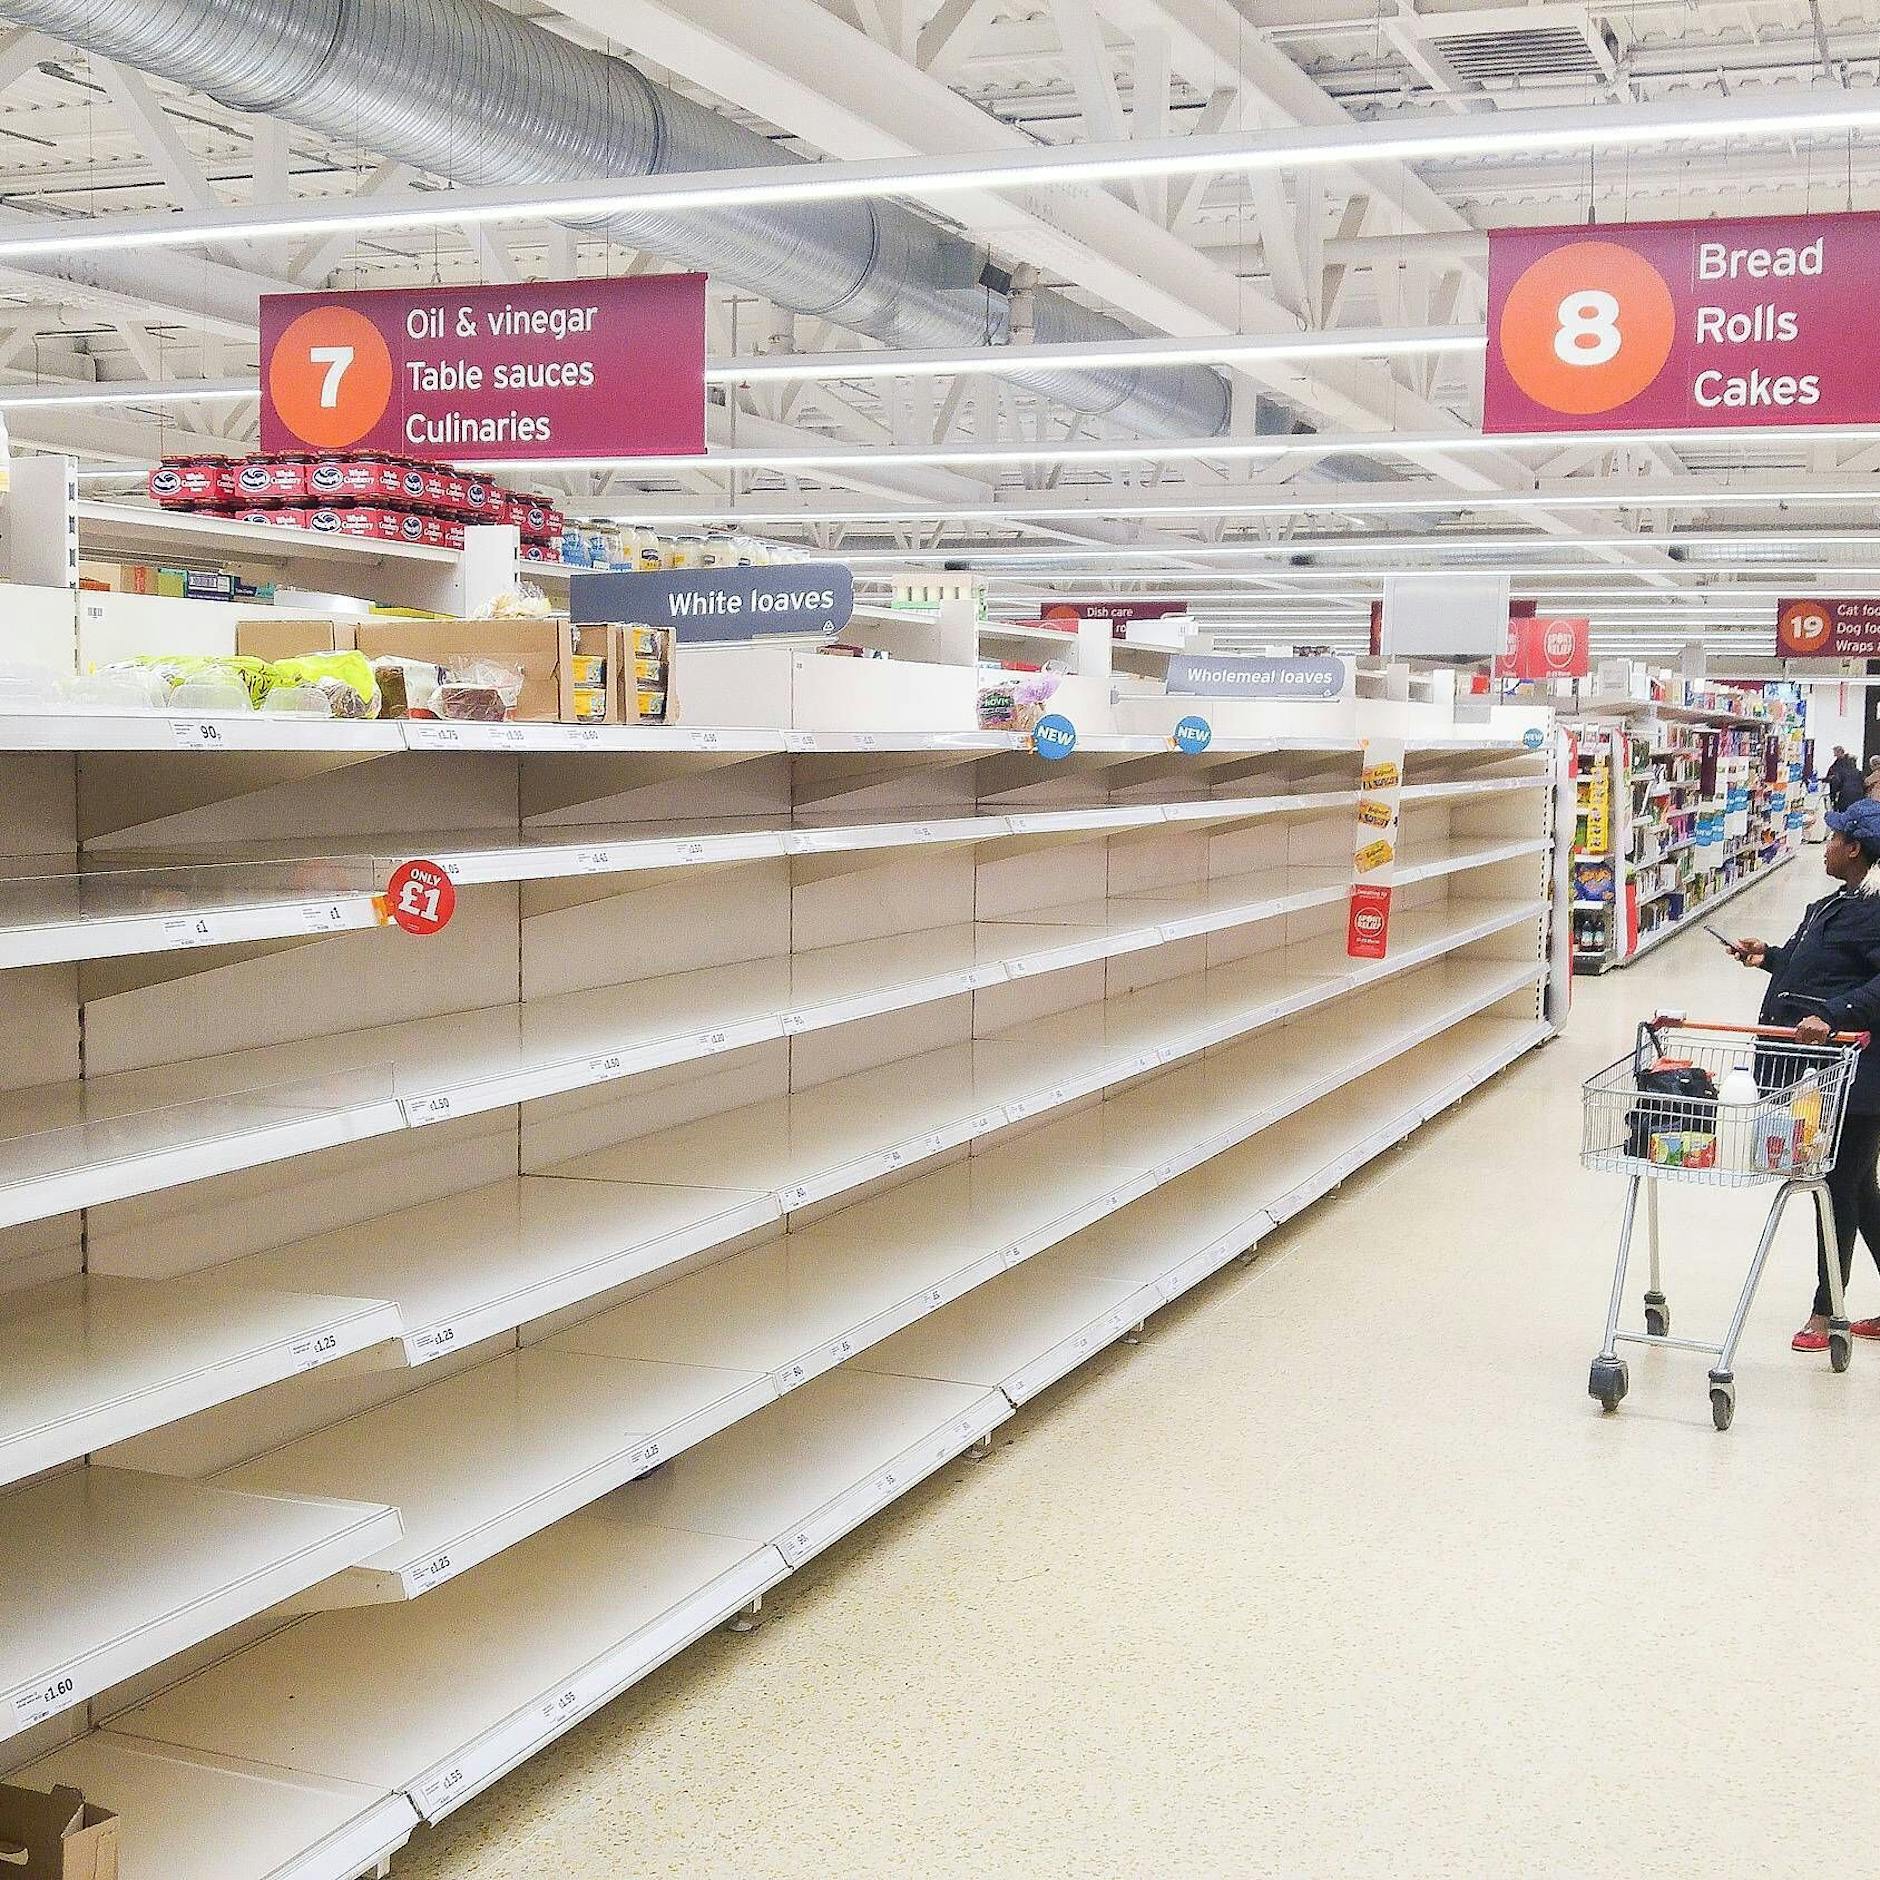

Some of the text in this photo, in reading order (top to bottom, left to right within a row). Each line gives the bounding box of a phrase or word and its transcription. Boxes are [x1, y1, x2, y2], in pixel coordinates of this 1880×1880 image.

[1698, 236, 1824, 280] Bread
[406, 303, 598, 341] Oil & vinegar
[1553, 289, 1622, 366] 8
[1696, 304, 1798, 344] Rolls
[309, 346, 354, 409] 7
[406, 358, 595, 392] Table sauces
[1694, 368, 1820, 407] Cakes
[405, 410, 551, 444] Culinaries
[667, 588, 834, 616] White loaves
[1837, 604, 1880, 616] Cat foo
[1087, 607, 1134, 617] Dish care
[1791, 615, 1824, 639] 19
[1836, 622, 1880, 637] Dog foo
[1836, 640, 1874, 653] Wraps
[1187, 668, 1333, 684] Wholemeal loaves
[1038, 725, 1074, 746] NEW
[1177, 726, 1210, 742] NEW
[410, 868, 442, 886] ONLY
[441, 863, 459, 874] 1.05
[398, 881, 441, 922] £1
[330, 906, 341, 921] £1
[195, 919, 208, 934] £1
[429, 1097, 450, 1112] £1.50
[314, 1335, 336, 1353] £1.25
[434, 1328, 454, 1345] £1.25
[430, 1555, 450, 1574] £1.25
[44, 1678, 73, 1702] £1.60
